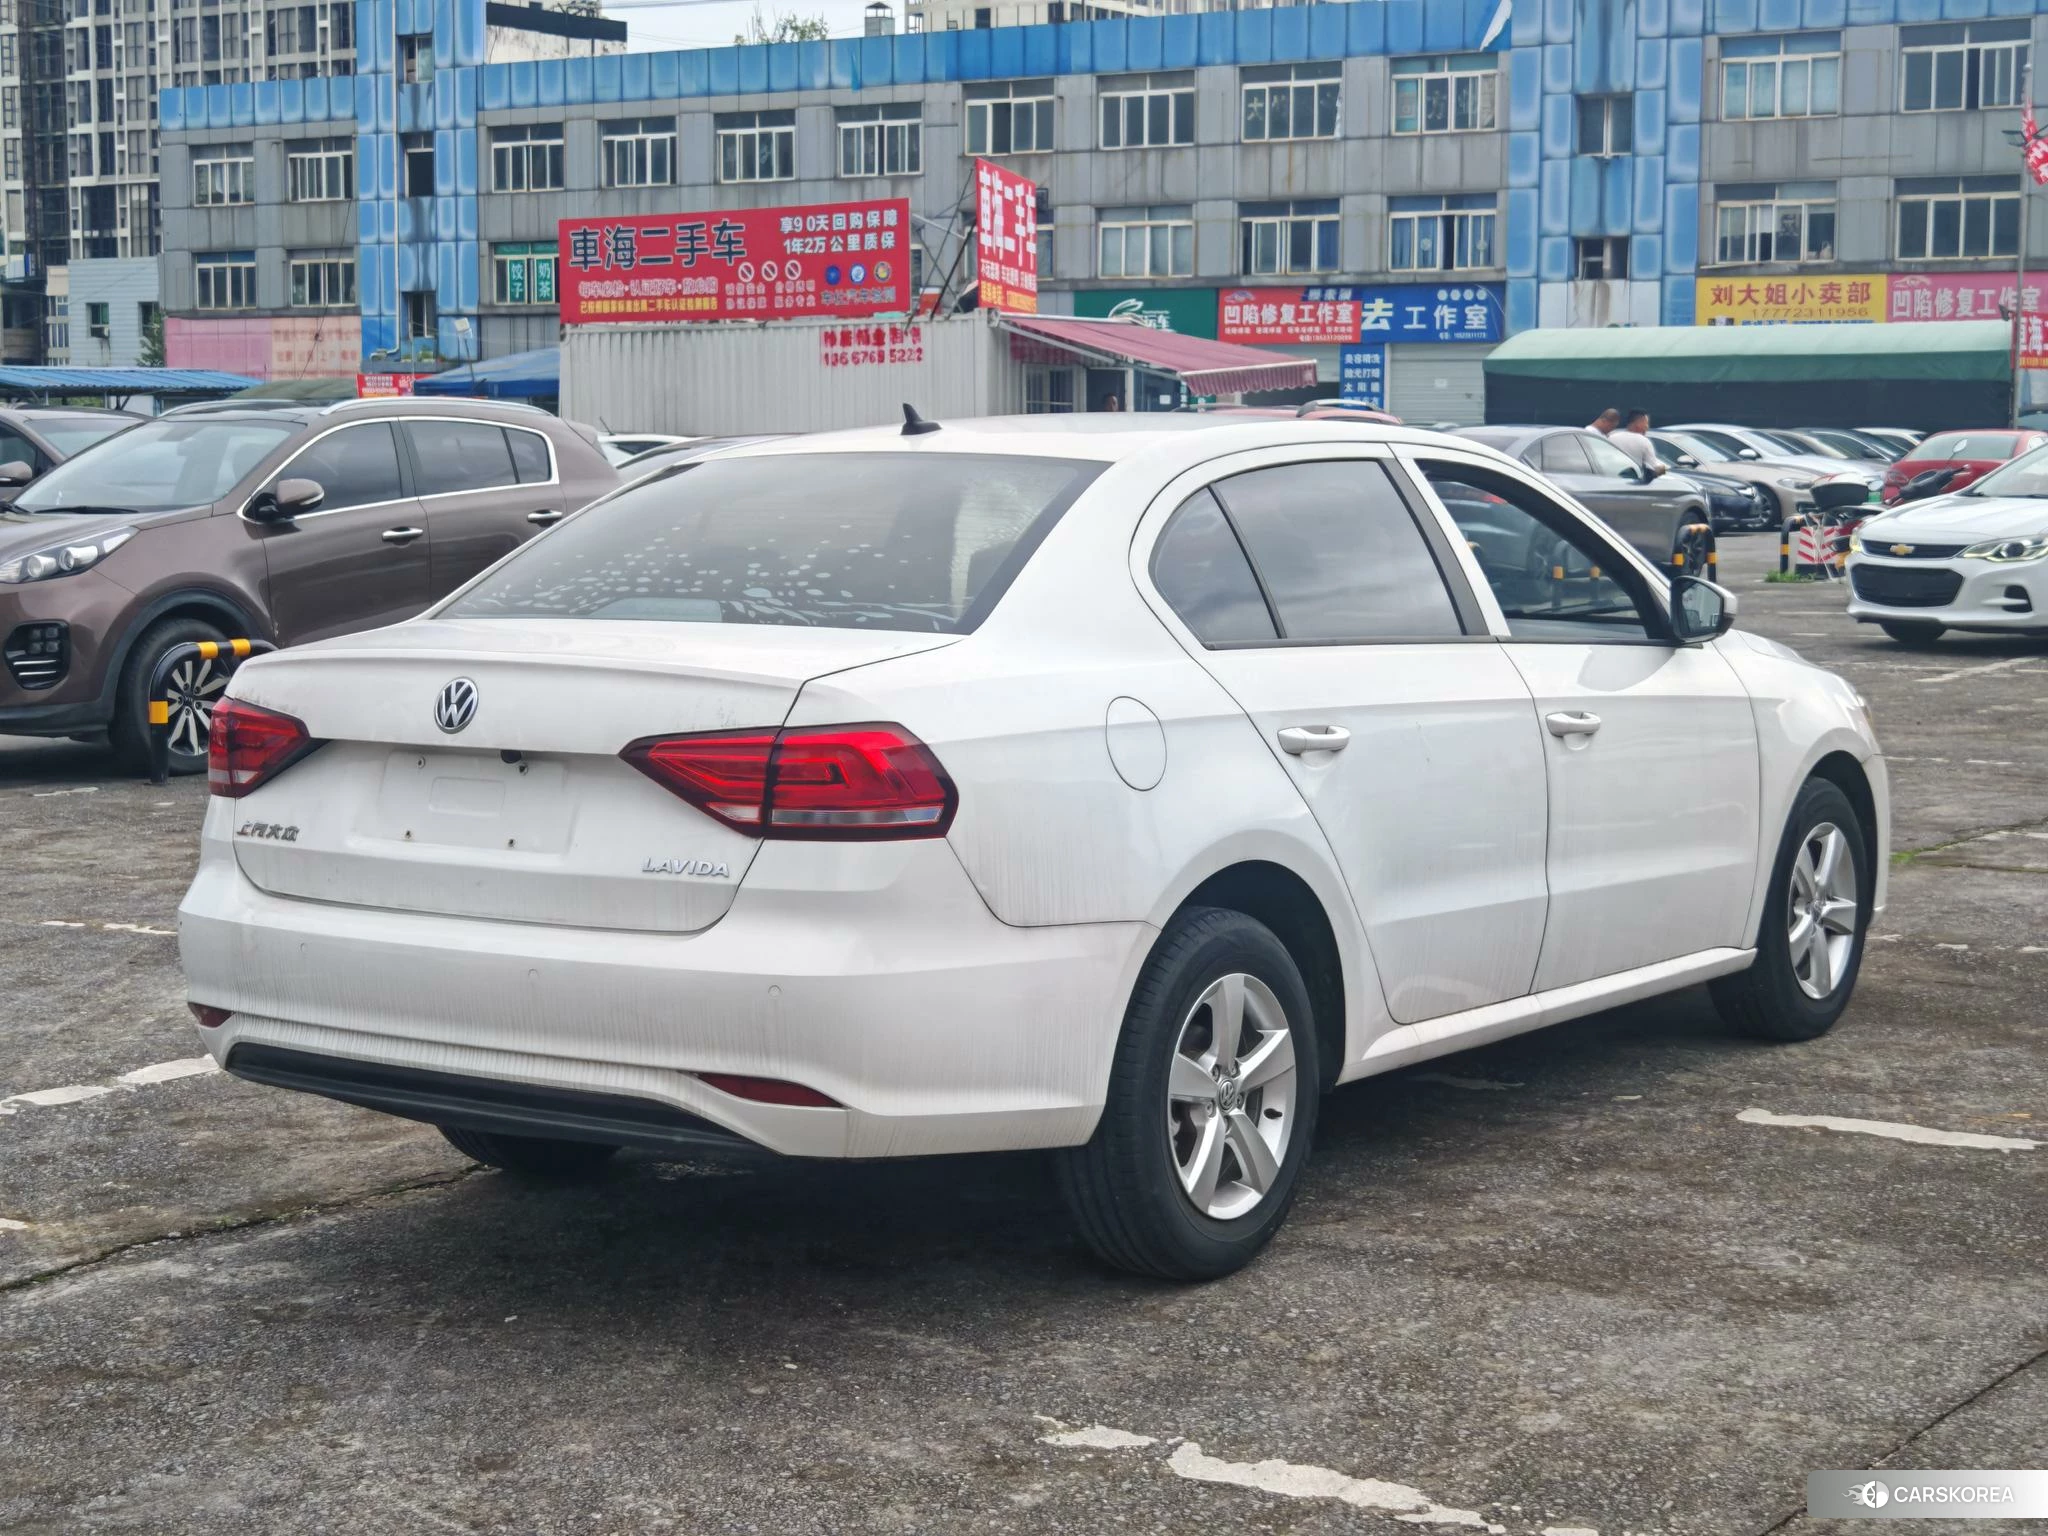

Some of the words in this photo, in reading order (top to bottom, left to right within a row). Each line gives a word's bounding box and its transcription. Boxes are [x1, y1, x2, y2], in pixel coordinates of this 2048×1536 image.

[569, 218, 748, 272] 車海二手车
[1710, 281, 1872, 306] 刘大姐小卖部
[1223, 302, 1354, 325] 凹陷修复工作室
[236, 820, 300, 843] 上汽大众
[642, 857, 729, 878] LAVIDA
